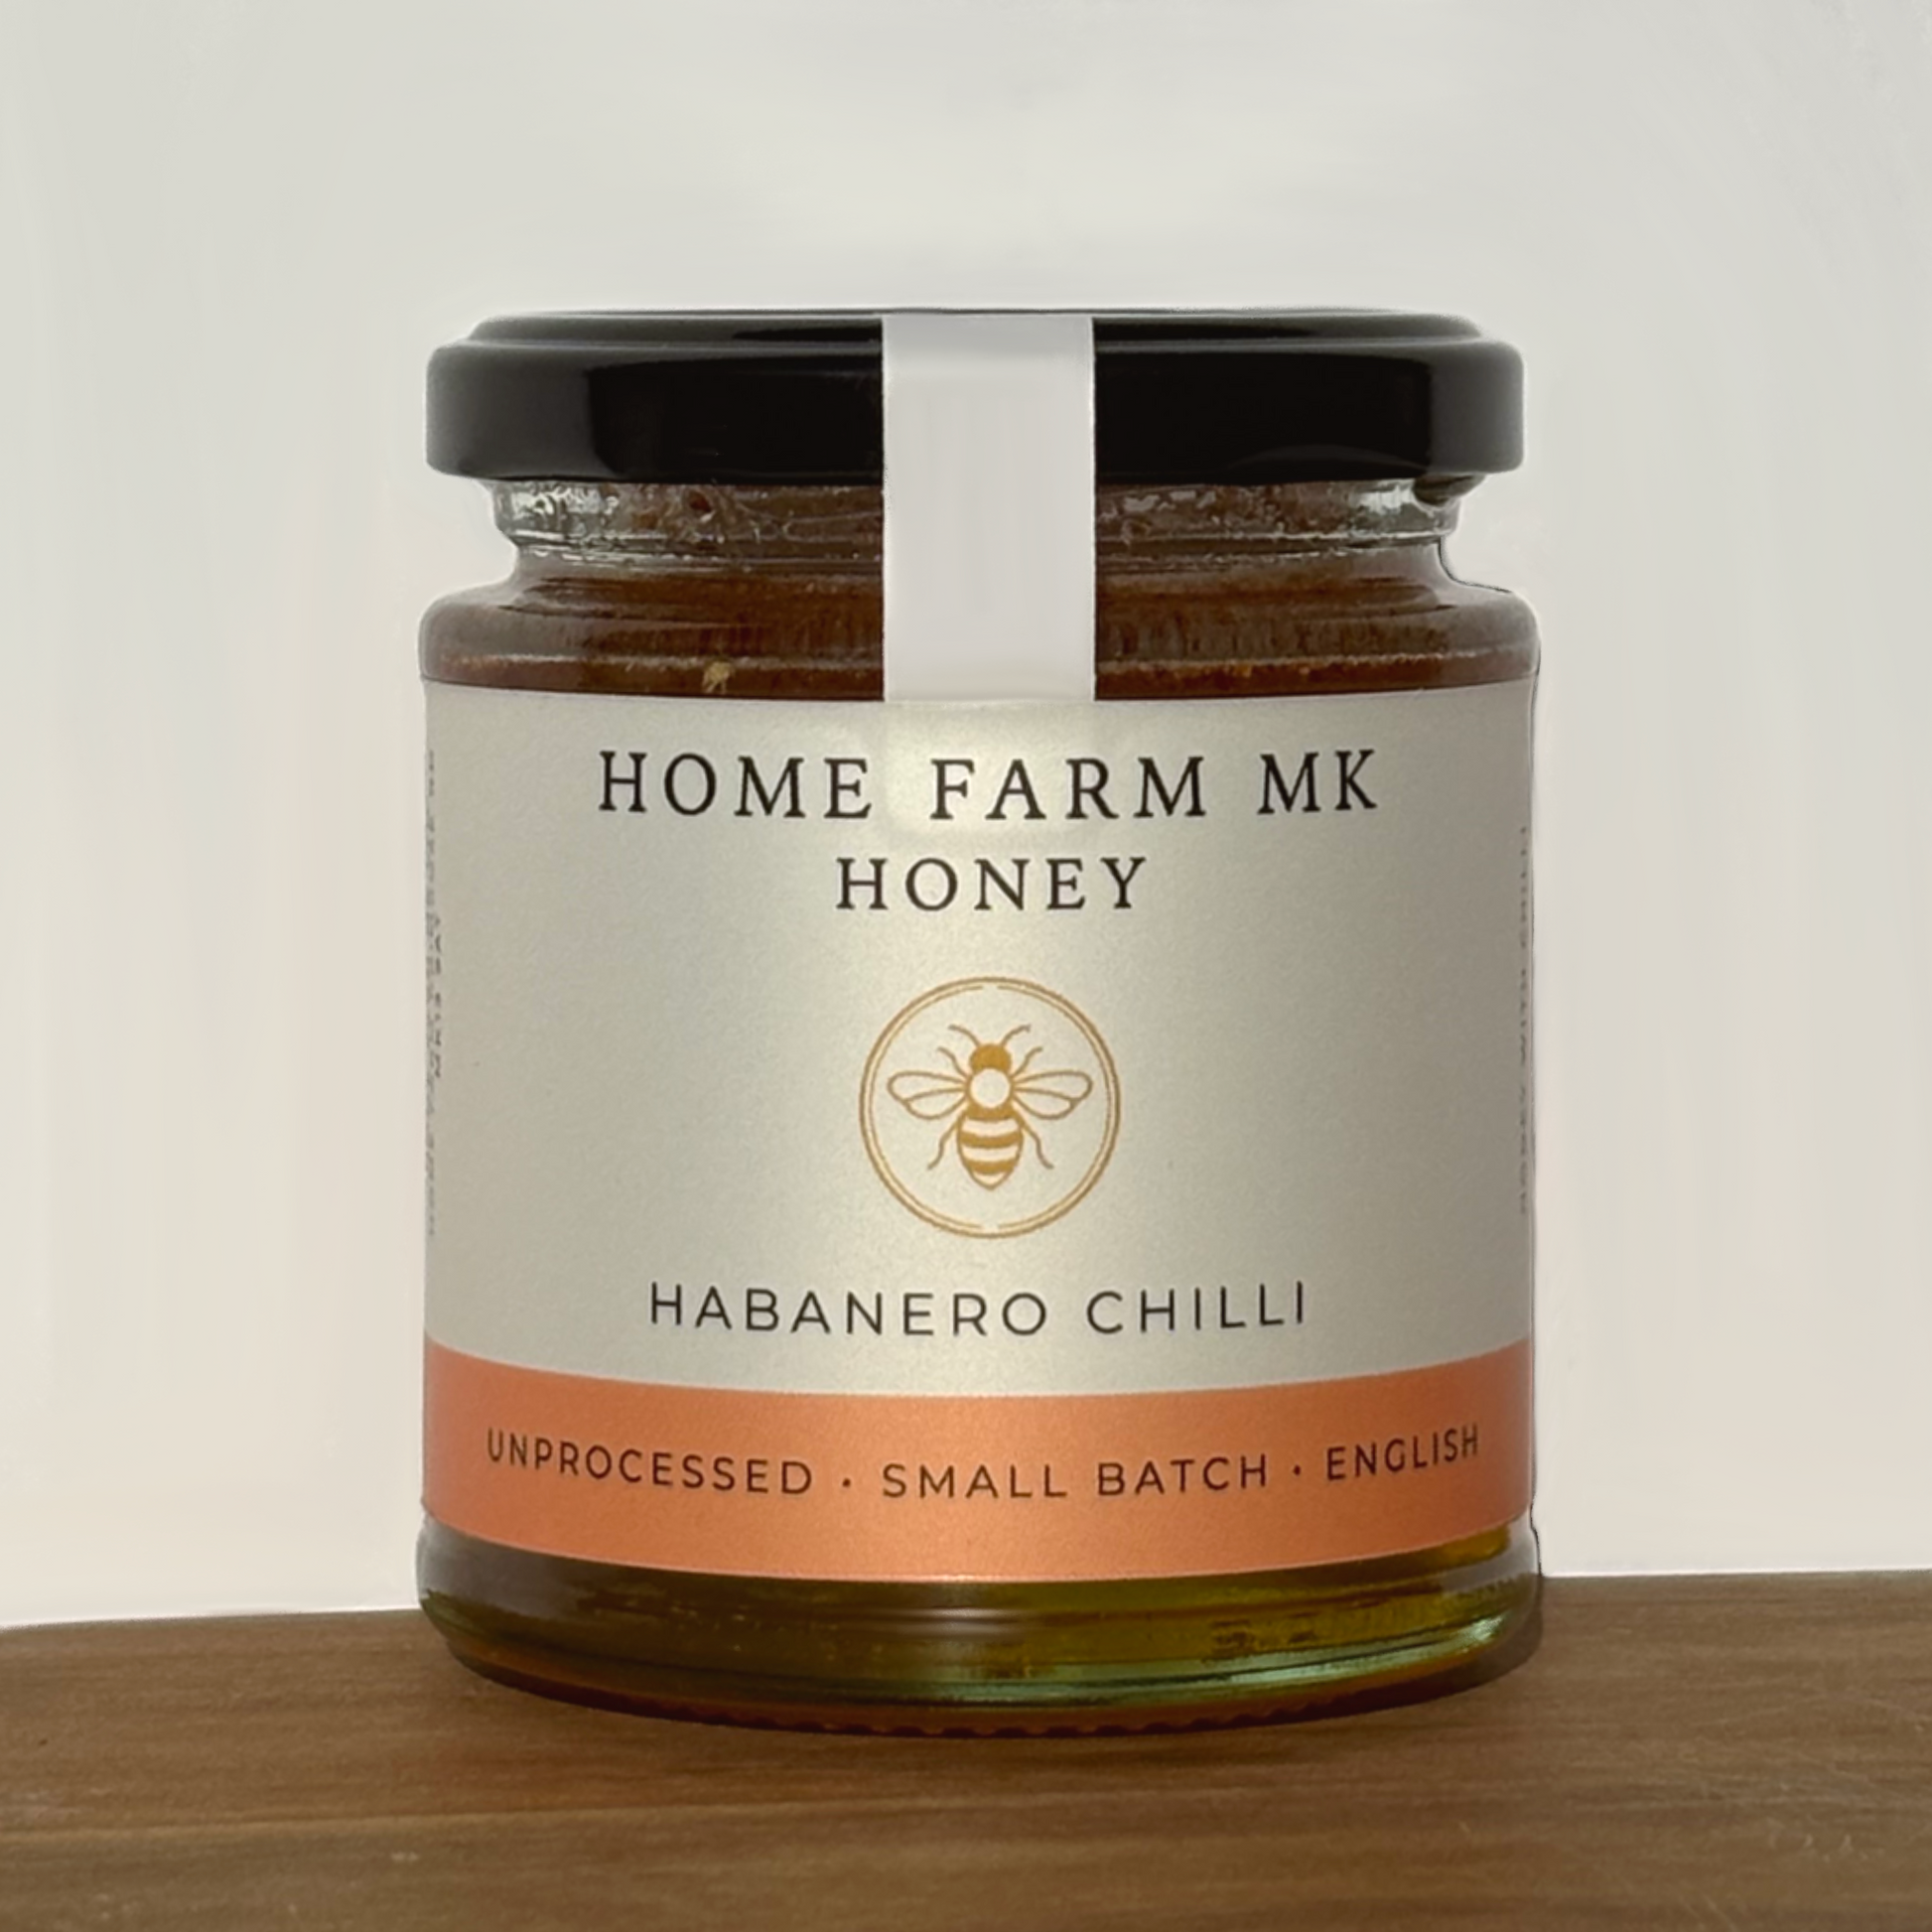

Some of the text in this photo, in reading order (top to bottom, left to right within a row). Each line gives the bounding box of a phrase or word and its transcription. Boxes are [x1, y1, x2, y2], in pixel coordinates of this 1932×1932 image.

[599, 750, 1377, 820] HOME FARM MK
[836, 857, 1146, 911] HONEY
[651, 1281, 1303, 1335] HABANERO CHILLI
[488, 1425, 1478, 1498] UNPROCESSED SMALL BATCH ENGLISH
